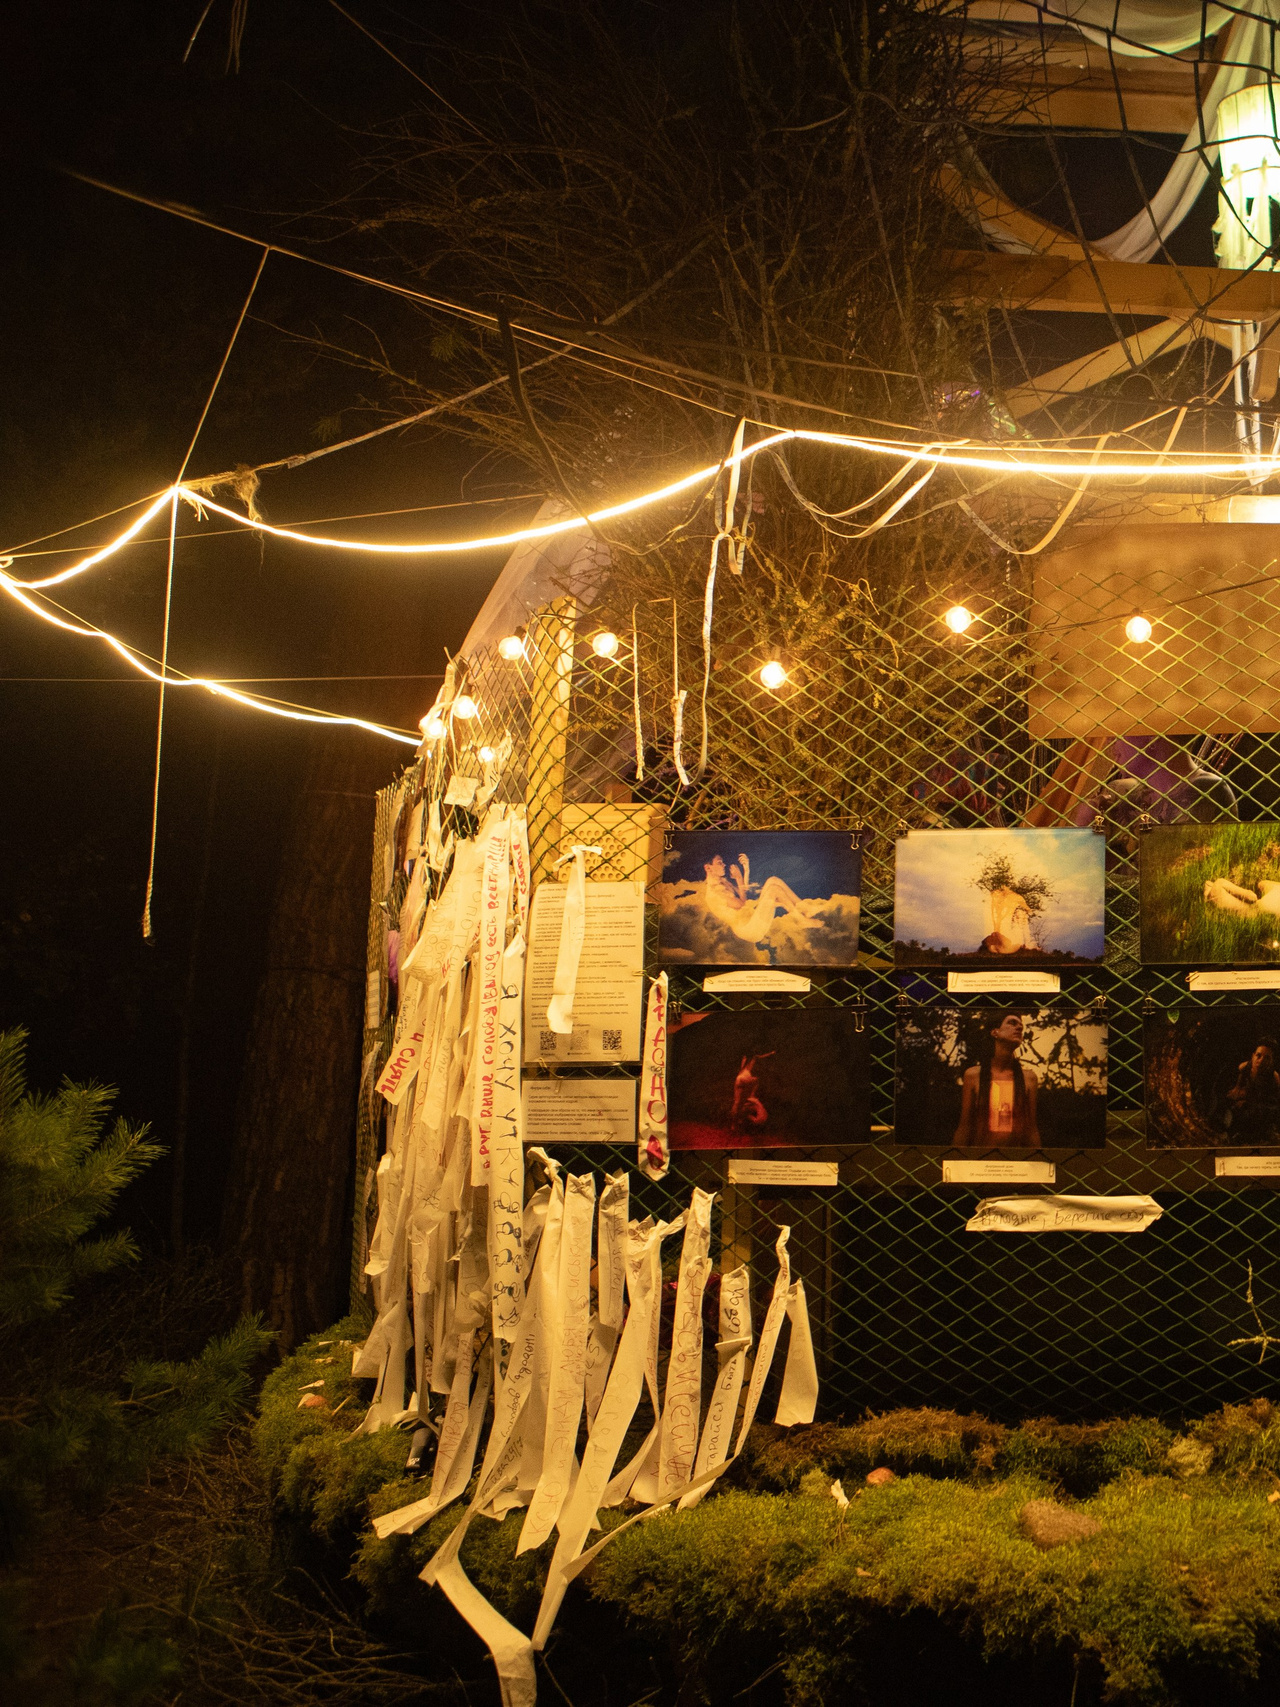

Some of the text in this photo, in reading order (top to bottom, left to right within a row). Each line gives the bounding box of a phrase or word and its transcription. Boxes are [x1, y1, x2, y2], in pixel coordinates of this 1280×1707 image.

[494, 983, 520, 1188] Я ХОЧУ УТКУ
